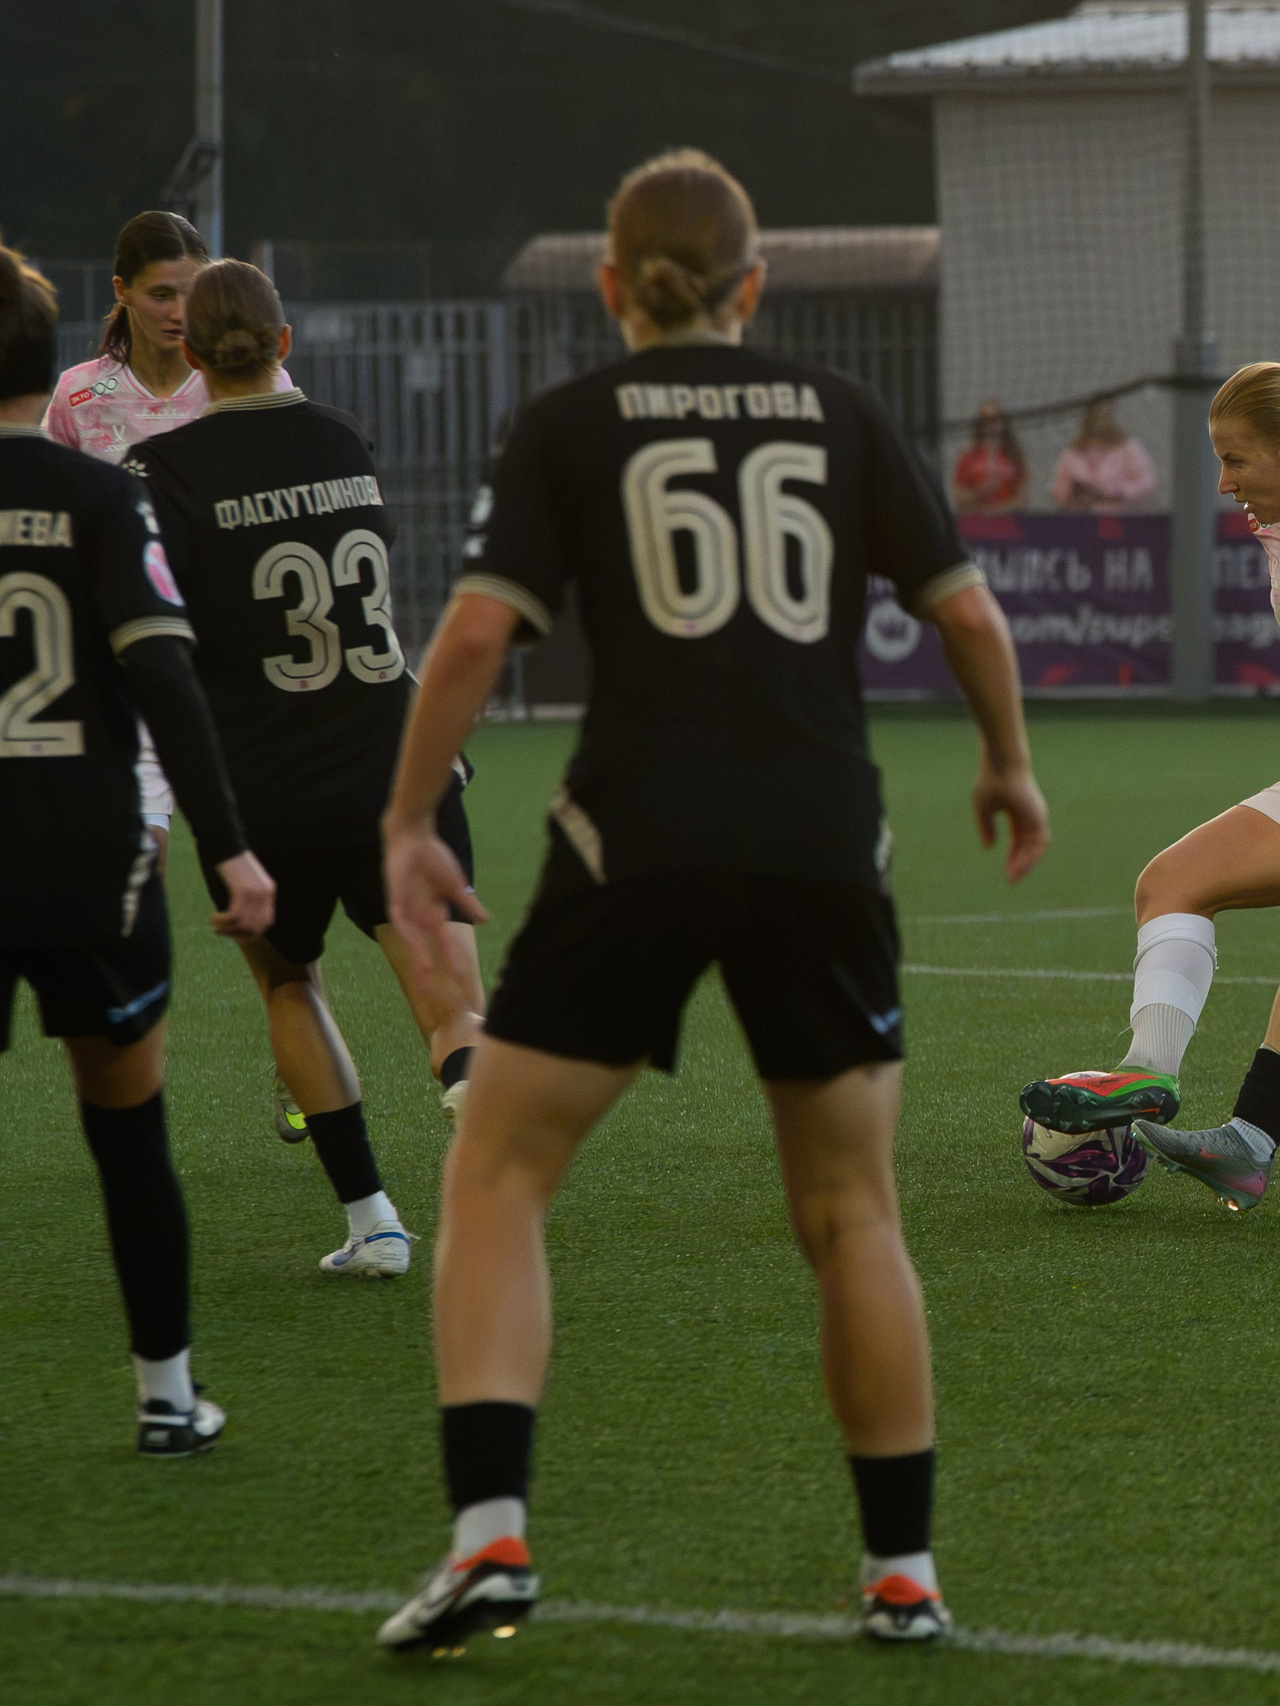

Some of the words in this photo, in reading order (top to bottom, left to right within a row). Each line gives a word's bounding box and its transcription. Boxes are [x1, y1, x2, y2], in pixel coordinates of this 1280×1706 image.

[615, 382, 825, 423] ПИРОГОВА
[214, 476, 384, 530] ФАСХУТДИНОВ
[622, 437, 835, 644] 66
[0, 572, 85, 756] 2
[252, 529, 406, 691] 33
